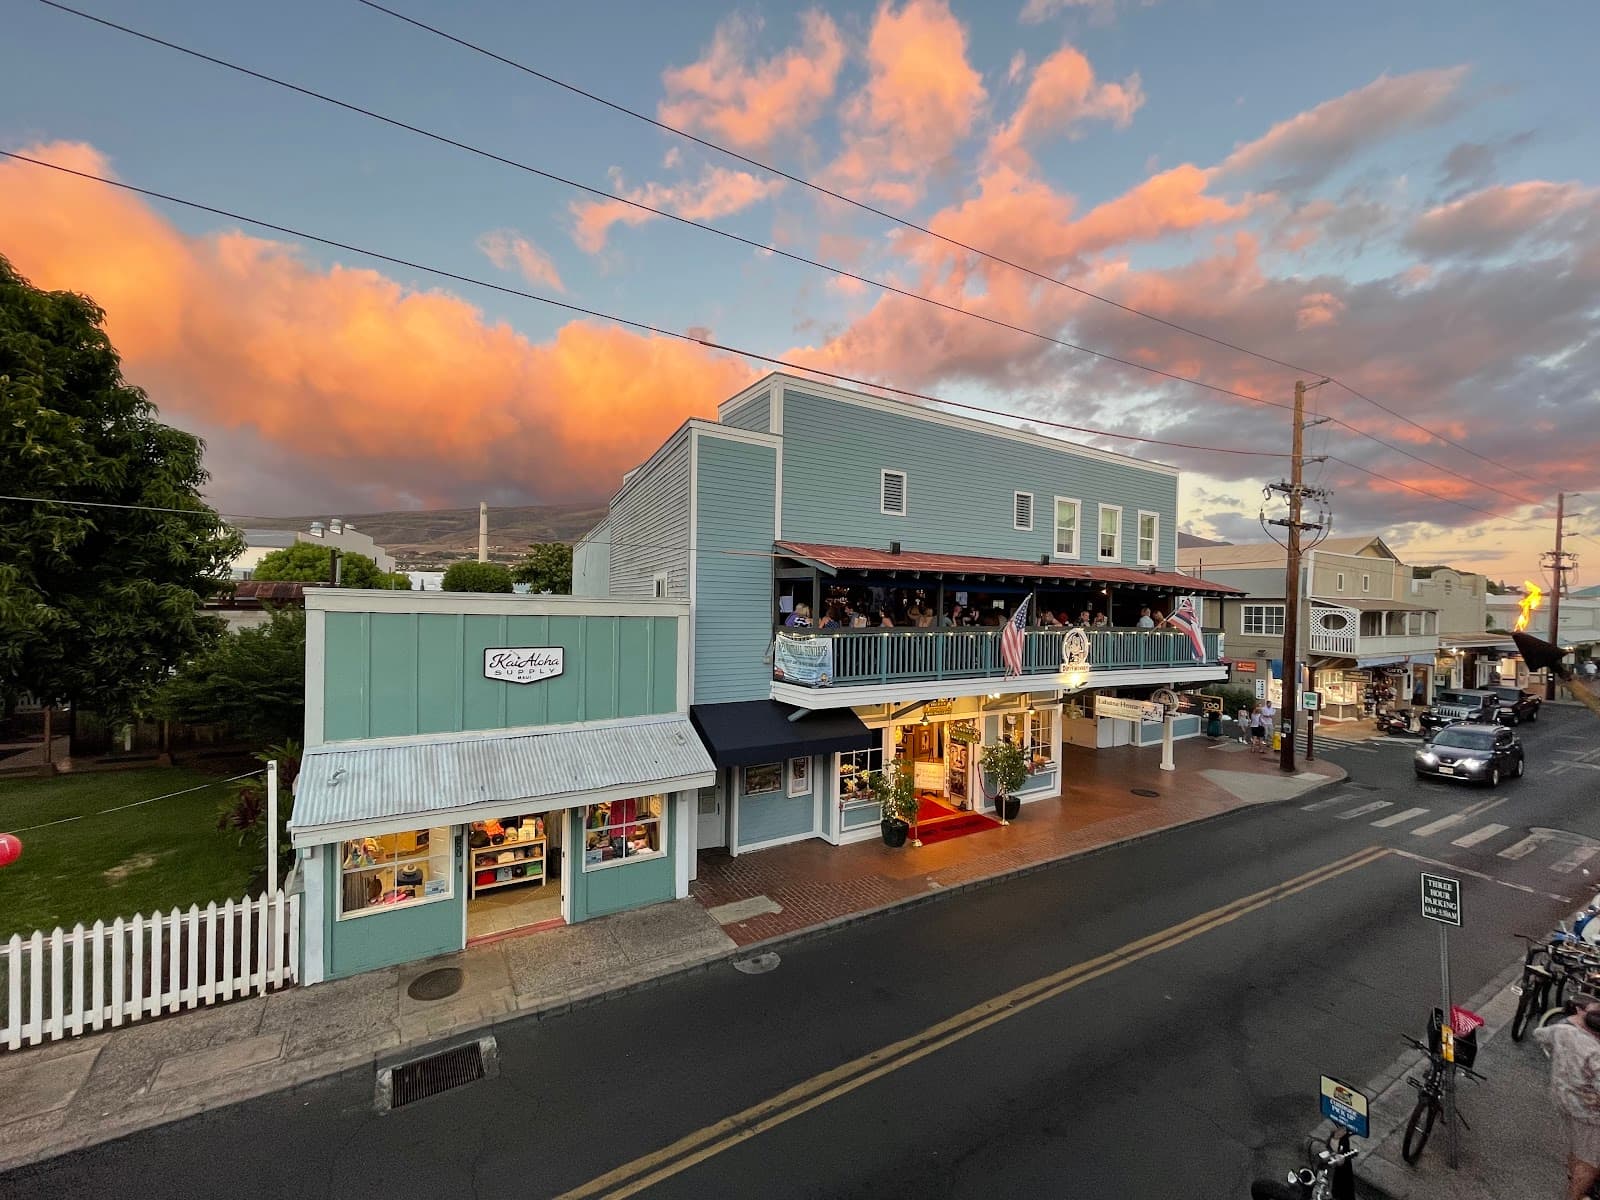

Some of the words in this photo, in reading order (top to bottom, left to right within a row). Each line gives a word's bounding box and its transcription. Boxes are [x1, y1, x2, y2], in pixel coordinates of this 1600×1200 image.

[1202, 701, 1220, 710] TOO
[1427, 879, 1453, 892] THREE
[1430, 888, 1451, 901] HOUR
[1424, 896, 1457, 911] PARKING
